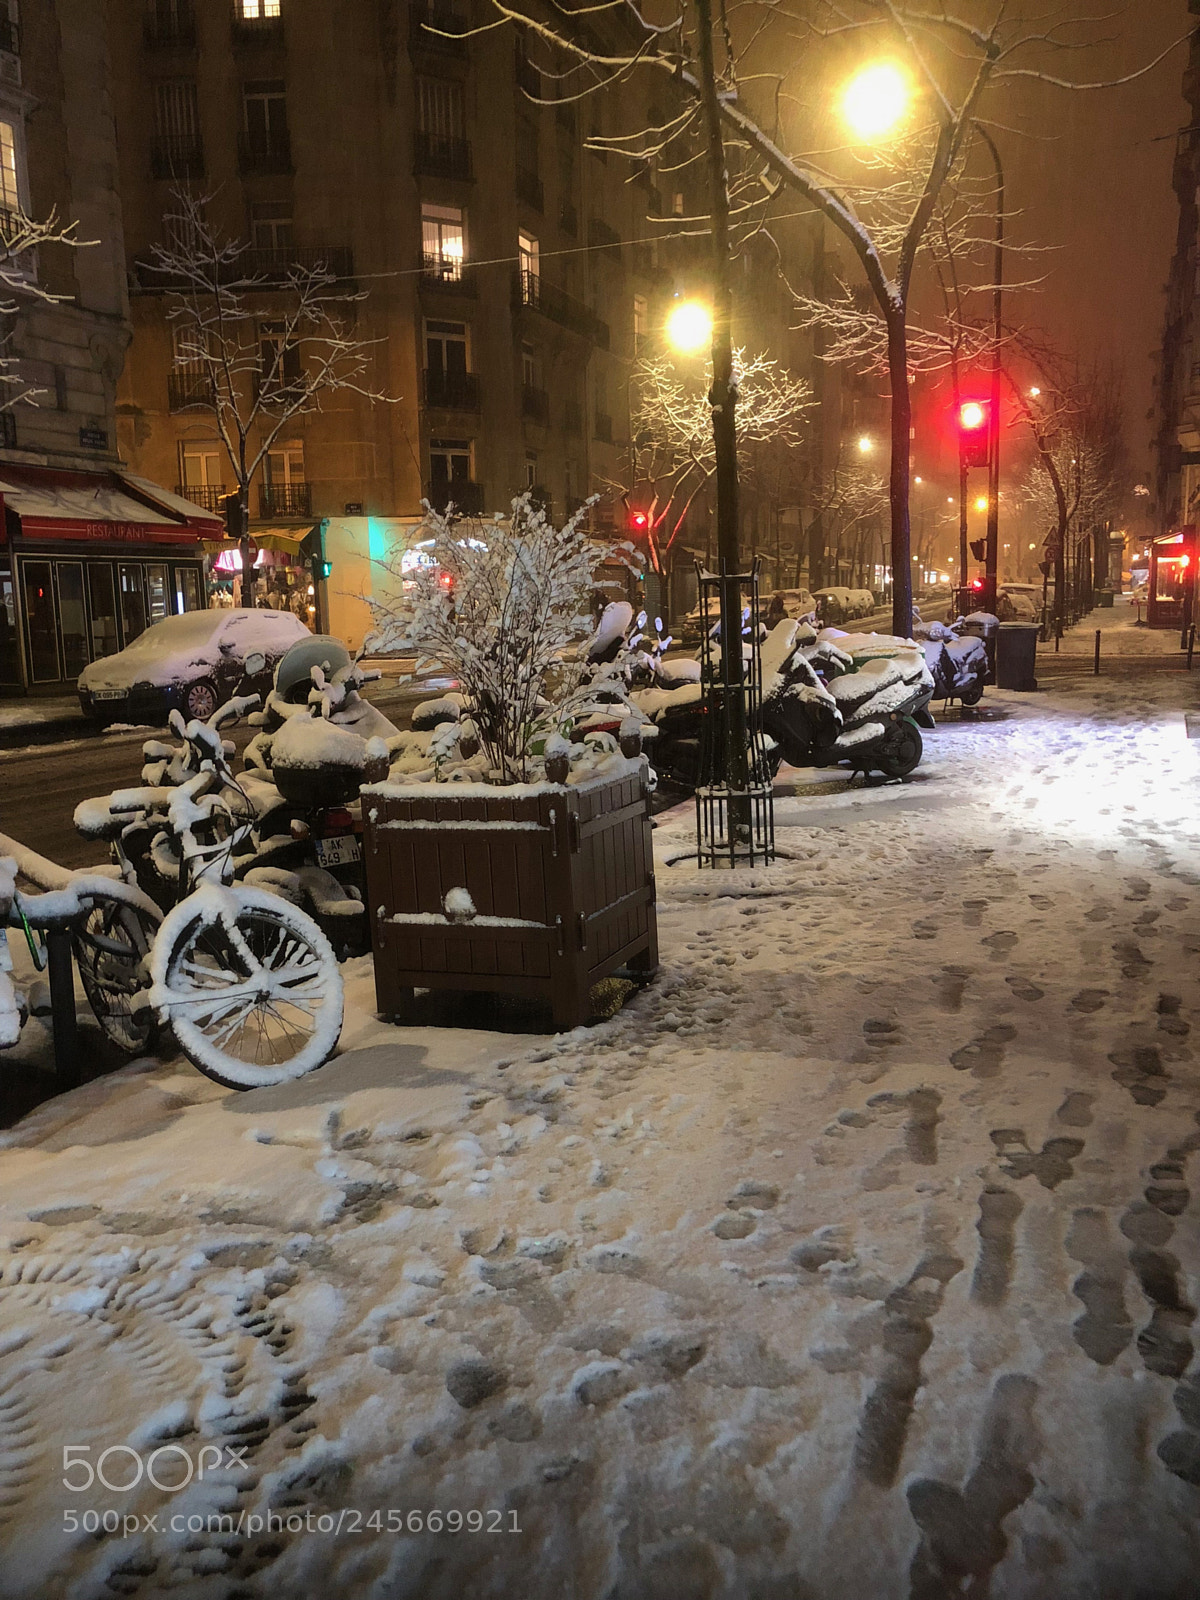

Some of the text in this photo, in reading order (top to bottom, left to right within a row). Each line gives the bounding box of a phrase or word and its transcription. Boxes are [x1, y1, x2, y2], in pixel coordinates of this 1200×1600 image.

[86, 524, 145, 539] RESTAURANT
[331, 839, 343, 850] AK
[320, 852, 340, 865] 649
